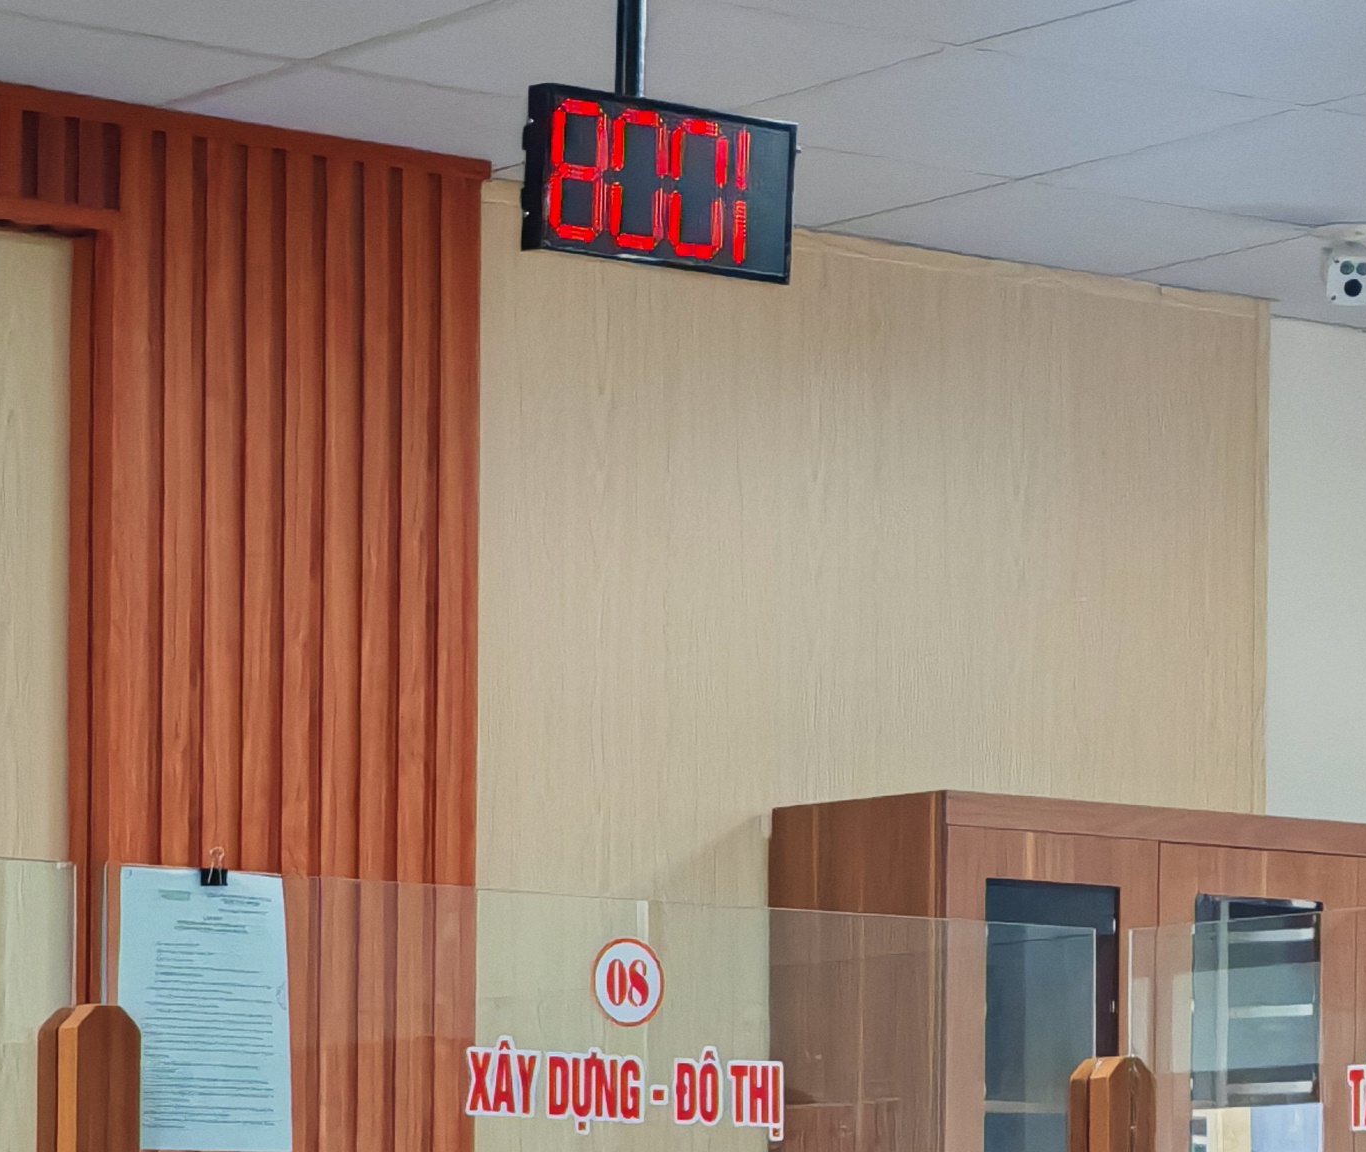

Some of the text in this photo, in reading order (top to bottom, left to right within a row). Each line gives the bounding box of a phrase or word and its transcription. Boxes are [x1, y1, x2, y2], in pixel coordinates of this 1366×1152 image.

[549, 98, 751, 266] 8001
[606, 958, 649, 1007] 08
[469, 1039, 537, 1115] XÂY
[547, 1052, 641, 1132] DỰNG
[675, 1050, 720, 1123] ĐÔ
[730, 1065, 781, 1138] THỊ
